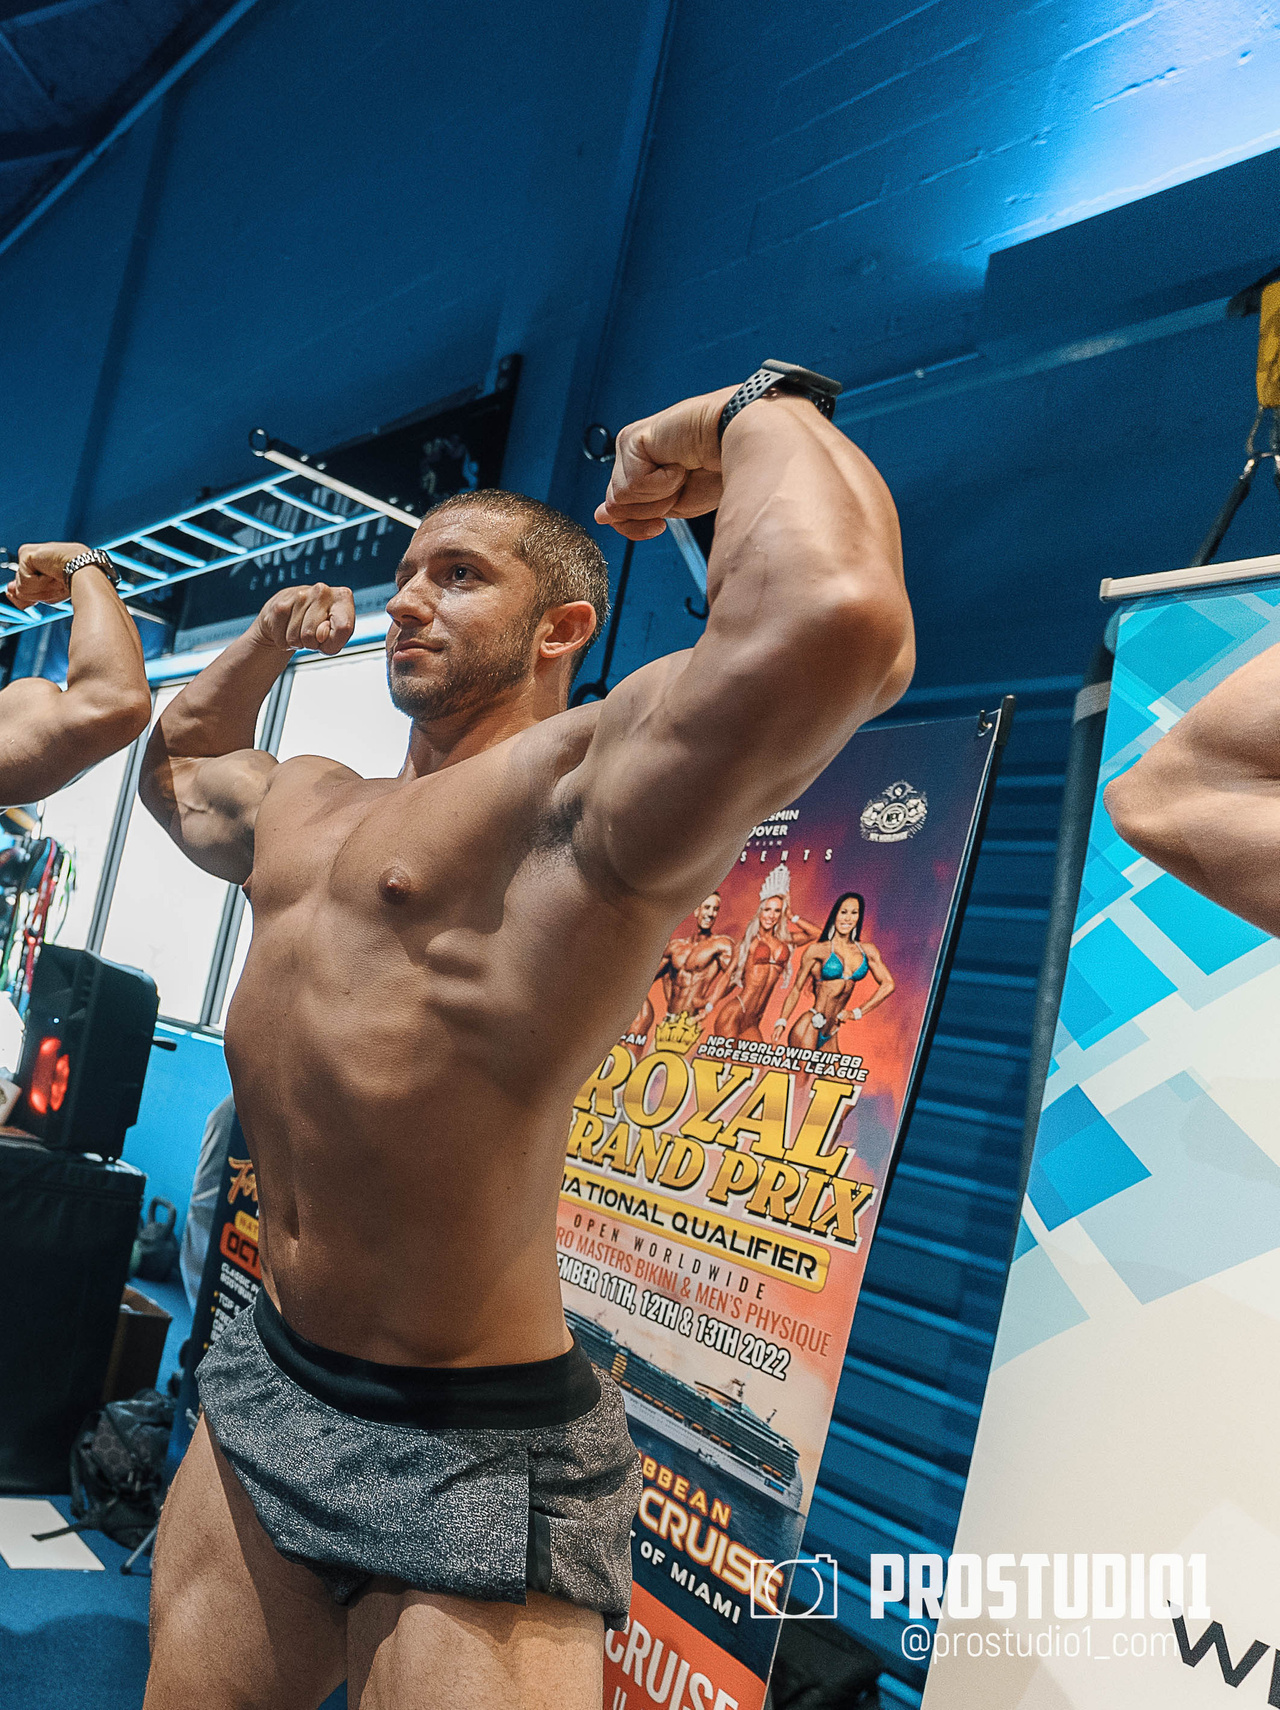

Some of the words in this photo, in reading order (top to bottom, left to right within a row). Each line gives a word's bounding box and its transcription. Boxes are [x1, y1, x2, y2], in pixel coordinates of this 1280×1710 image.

[762, 809, 800, 822] SMIN
[697, 1044, 801, 1071] PROFESSIONAL
[804, 1061, 869, 1082] LEAGUE
[706, 1034, 736, 1047] NPC
[572, 1046, 857, 1176] ROYAL
[706, 1149, 874, 1242] PRIX
[574, 1214, 620, 1243] OPEN
[634, 1236, 766, 1300] WORLDWIDE
[671, 1211, 818, 1279] QUALIFIER
[576, 1235, 633, 1273] MASTERS
[635, 1258, 678, 1293] BIKINI
[680, 1277, 691, 1299] &
[695, 1281, 742, 1320] MEN'S
[745, 1304, 832, 1357] PHYSIQUE
[601, 1272, 636, 1315] 11TH,
[640, 1290, 681, 1332] 12TH
[678, 1307, 693, 1337] &
[695, 1313, 741, 1358] 13TH
[737, 1334, 791, 1382] 2022
[639, 1453, 732, 1530] BBEAN
[638, 1486, 784, 1616] CRUISE
[640, 1540, 666, 1567] OF
[670, 1561, 741, 1624] MIAMI
[1167, 1600, 1280, 1710] W
